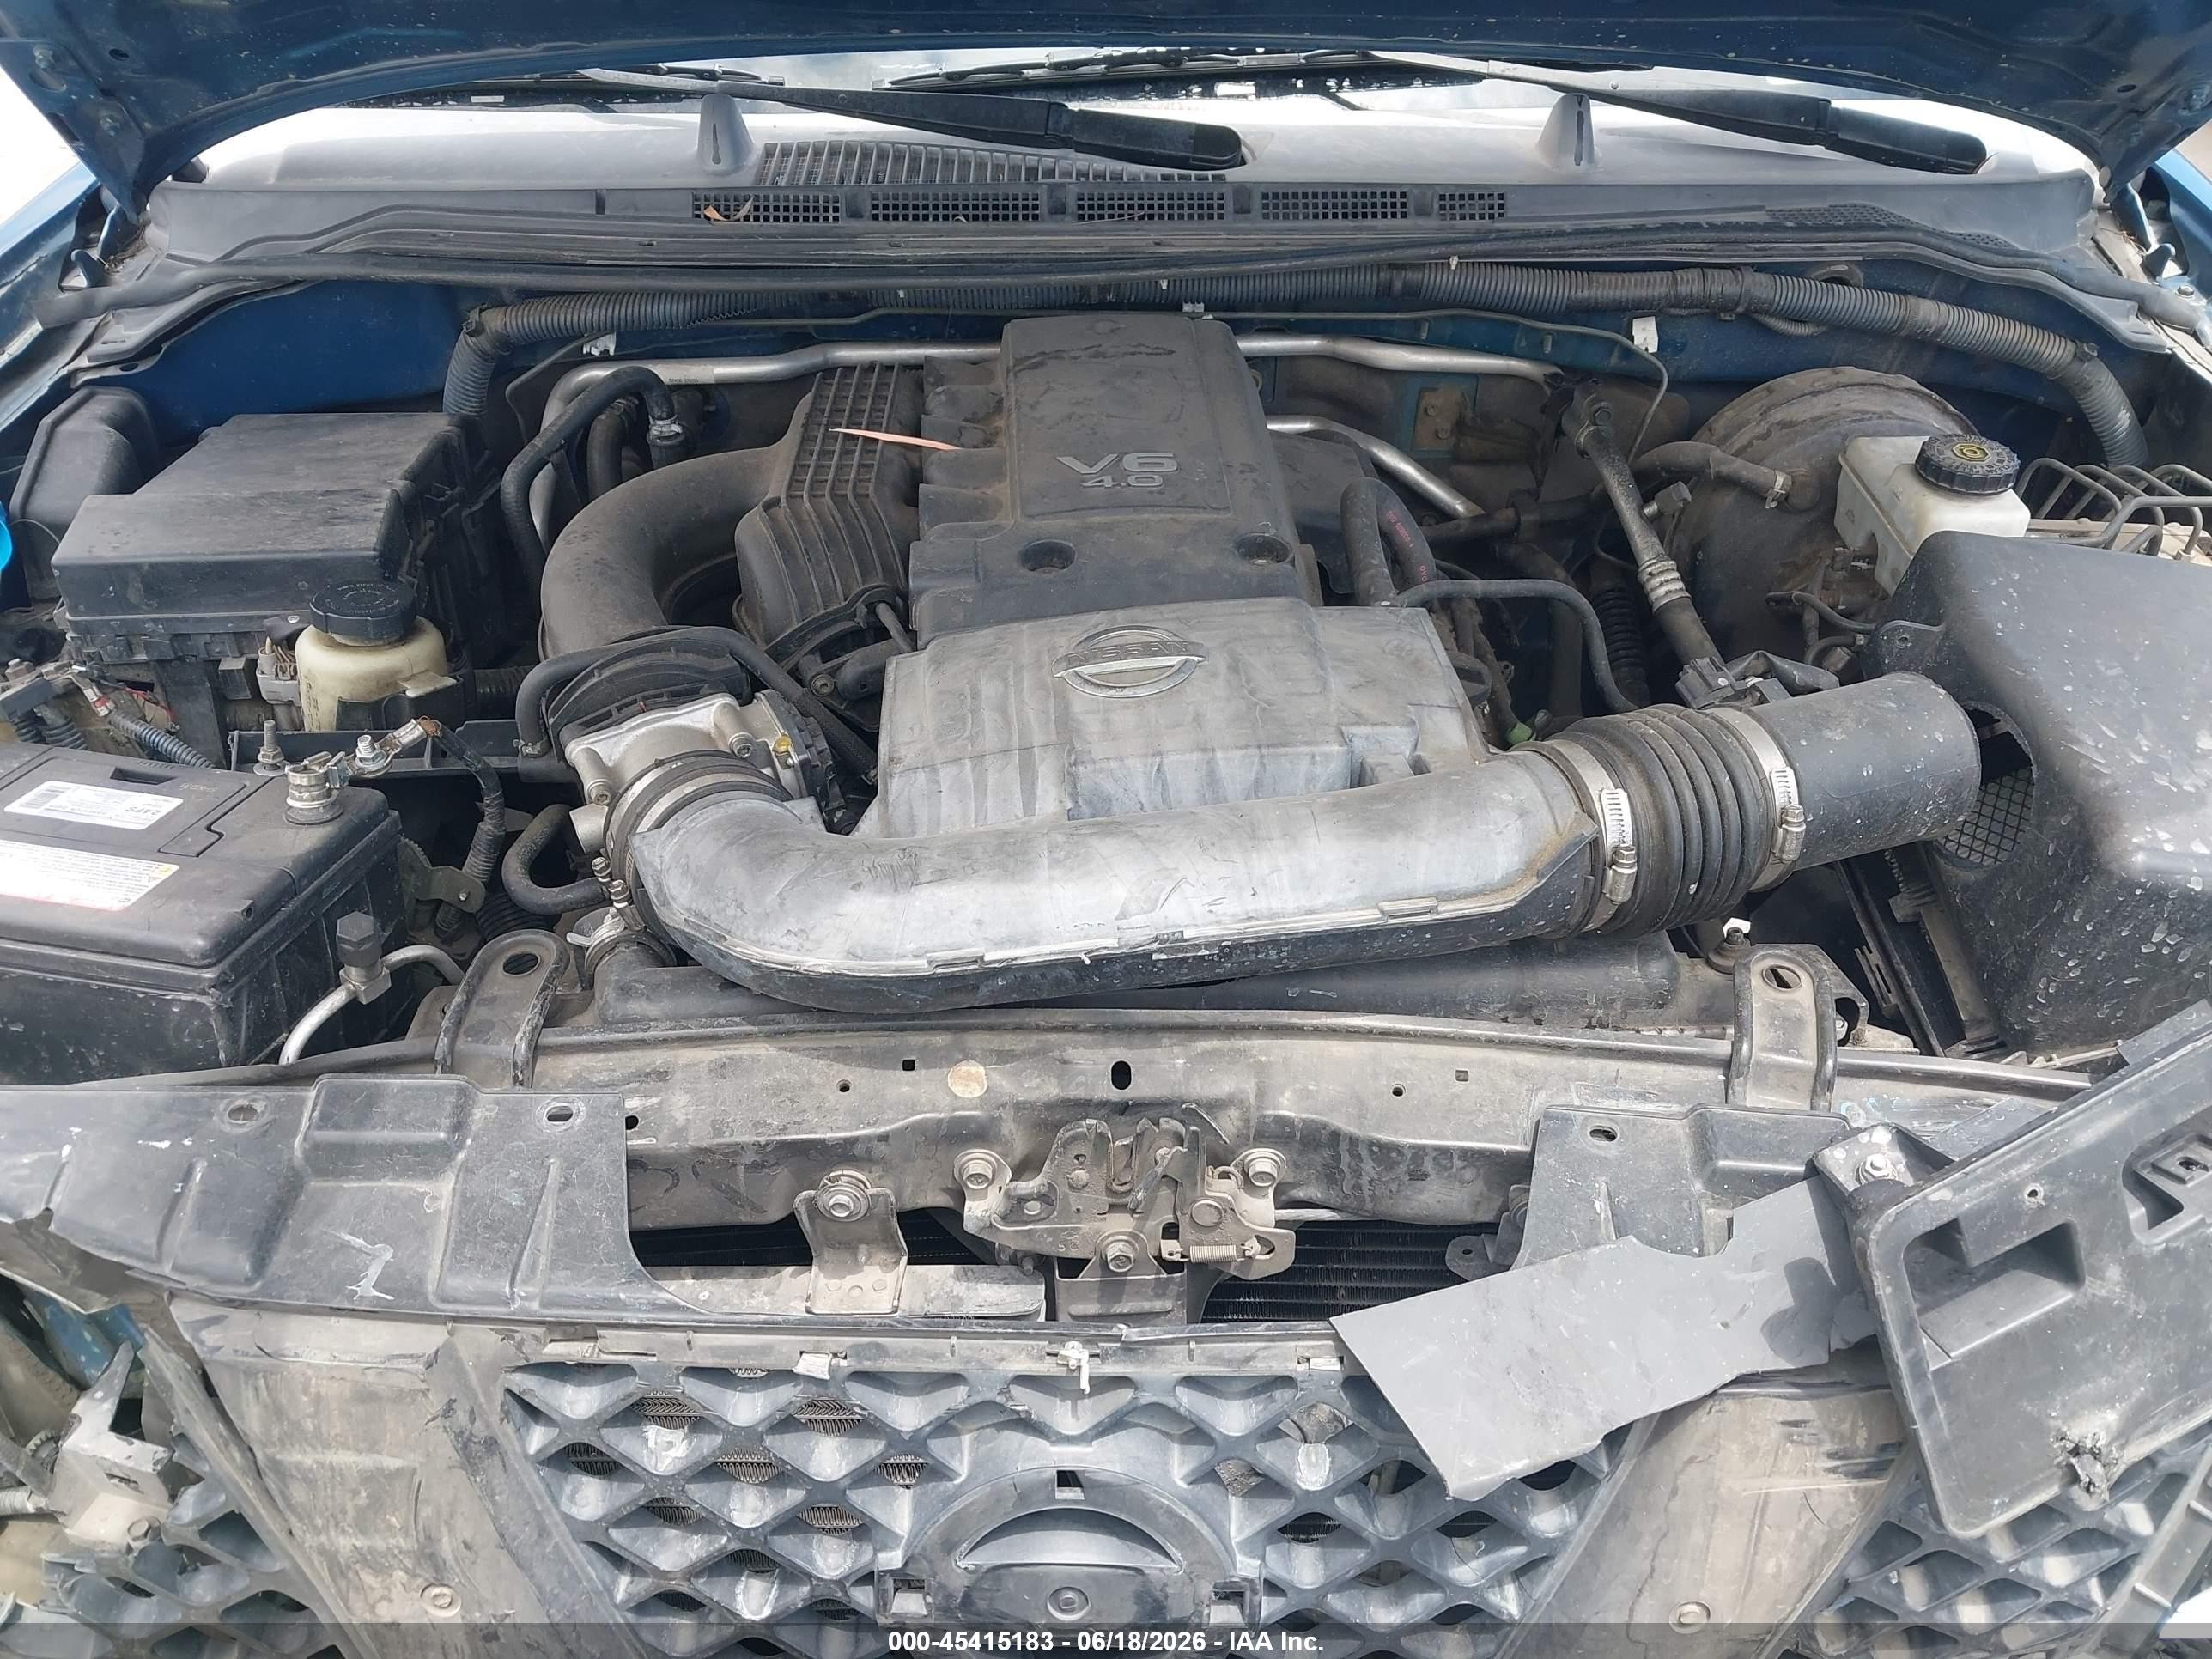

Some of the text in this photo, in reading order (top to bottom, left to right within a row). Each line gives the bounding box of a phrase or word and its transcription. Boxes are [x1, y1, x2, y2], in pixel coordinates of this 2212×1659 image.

[1056, 452, 1179, 474] V6
[1080, 474, 1164, 488] 4.0
[1067, 641, 1189, 665] NISSAN
